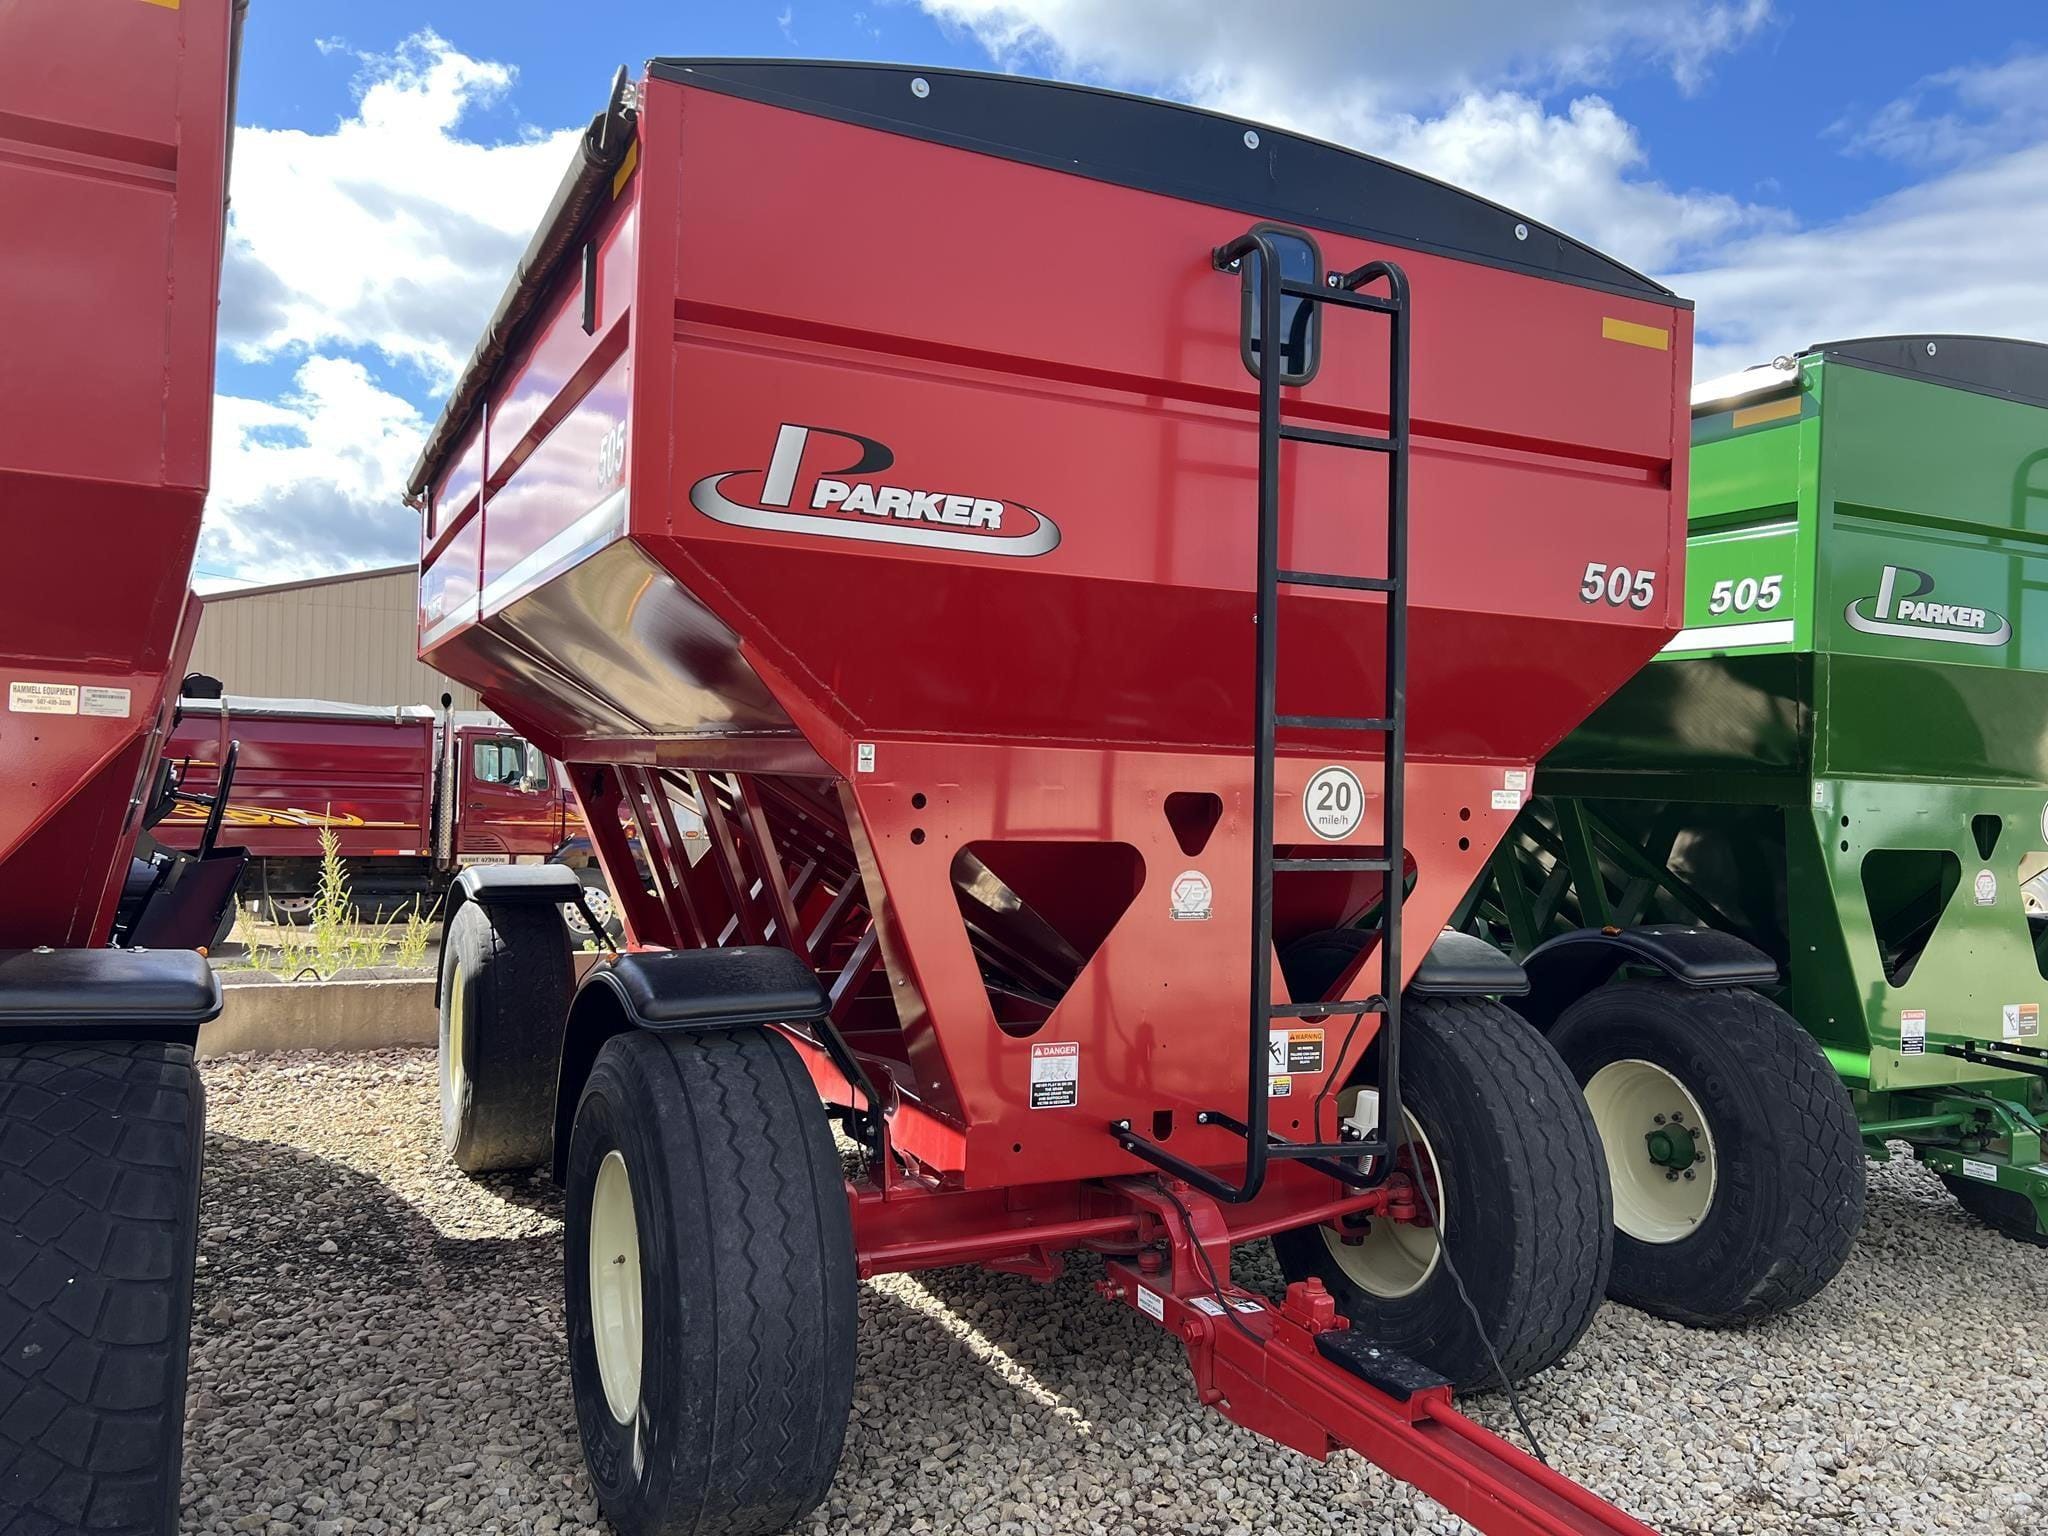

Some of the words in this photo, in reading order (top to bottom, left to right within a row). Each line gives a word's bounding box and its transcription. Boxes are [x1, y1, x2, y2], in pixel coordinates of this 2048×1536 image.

[598, 420, 625, 487] 505
[811, 478, 1004, 530] PARKER
[1579, 562, 1656, 610] 505
[1708, 575, 1782, 616] 505
[1897, 600, 1986, 628] PARKER
[1316, 781, 1352, 812] 20
[1319, 814, 1349, 825] mile/h
[1043, 1046, 1076, 1056] DANGER
